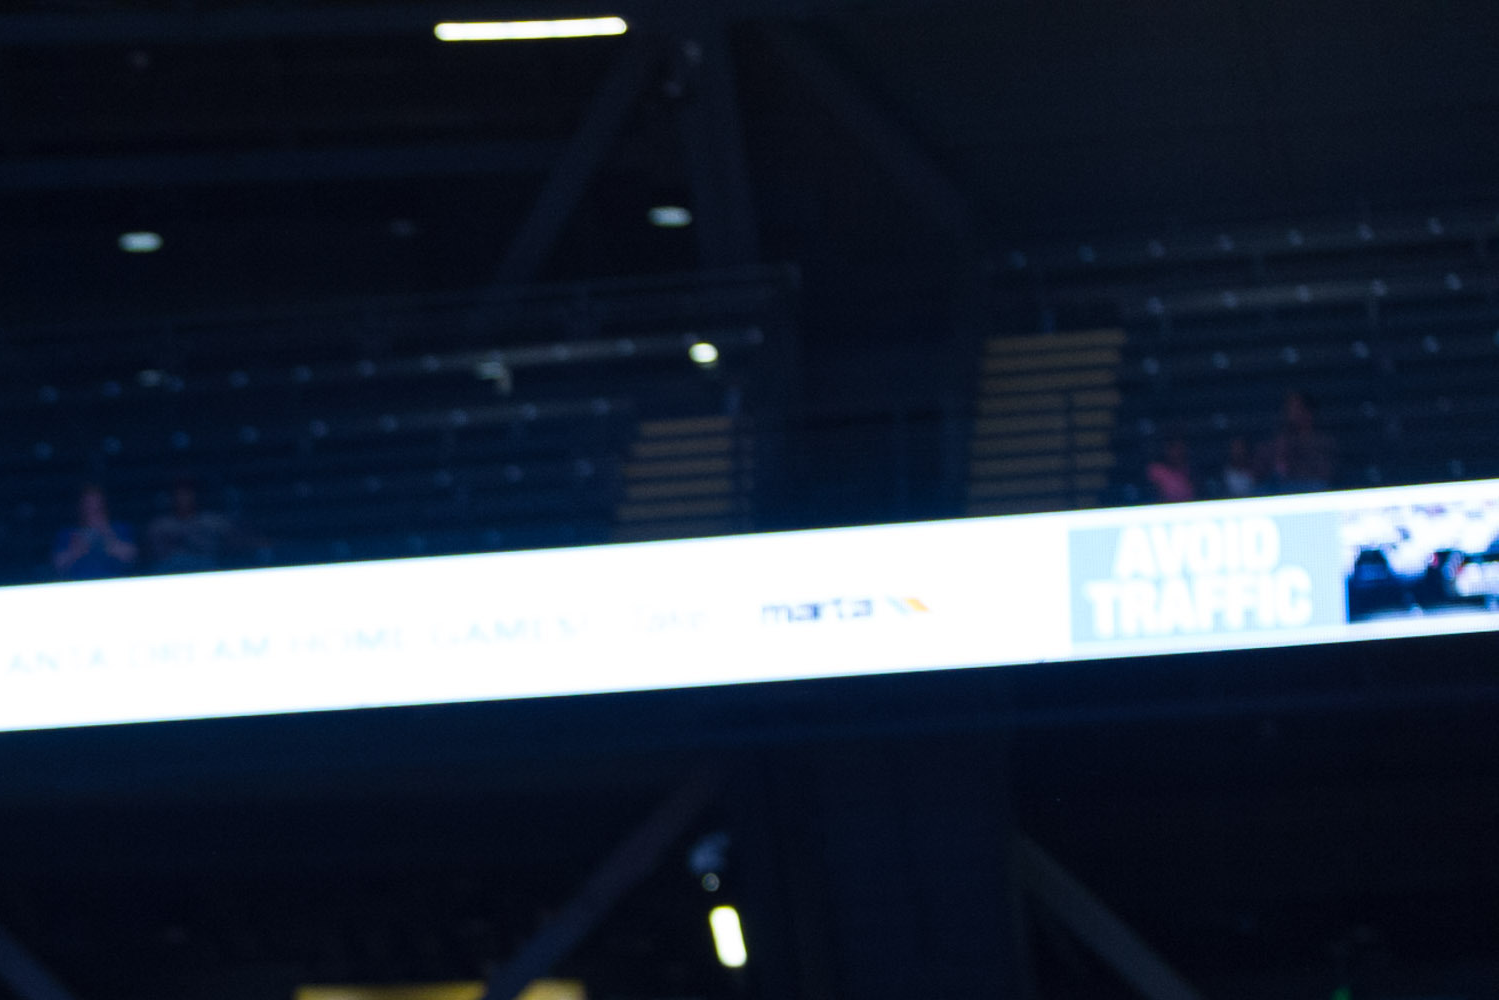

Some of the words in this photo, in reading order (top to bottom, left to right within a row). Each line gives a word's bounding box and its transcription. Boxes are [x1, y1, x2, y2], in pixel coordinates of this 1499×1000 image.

[1112, 516, 1281, 580] AVOID
[761, 598, 873, 625] marta
[1083, 565, 1312, 640] TRAFFIC
